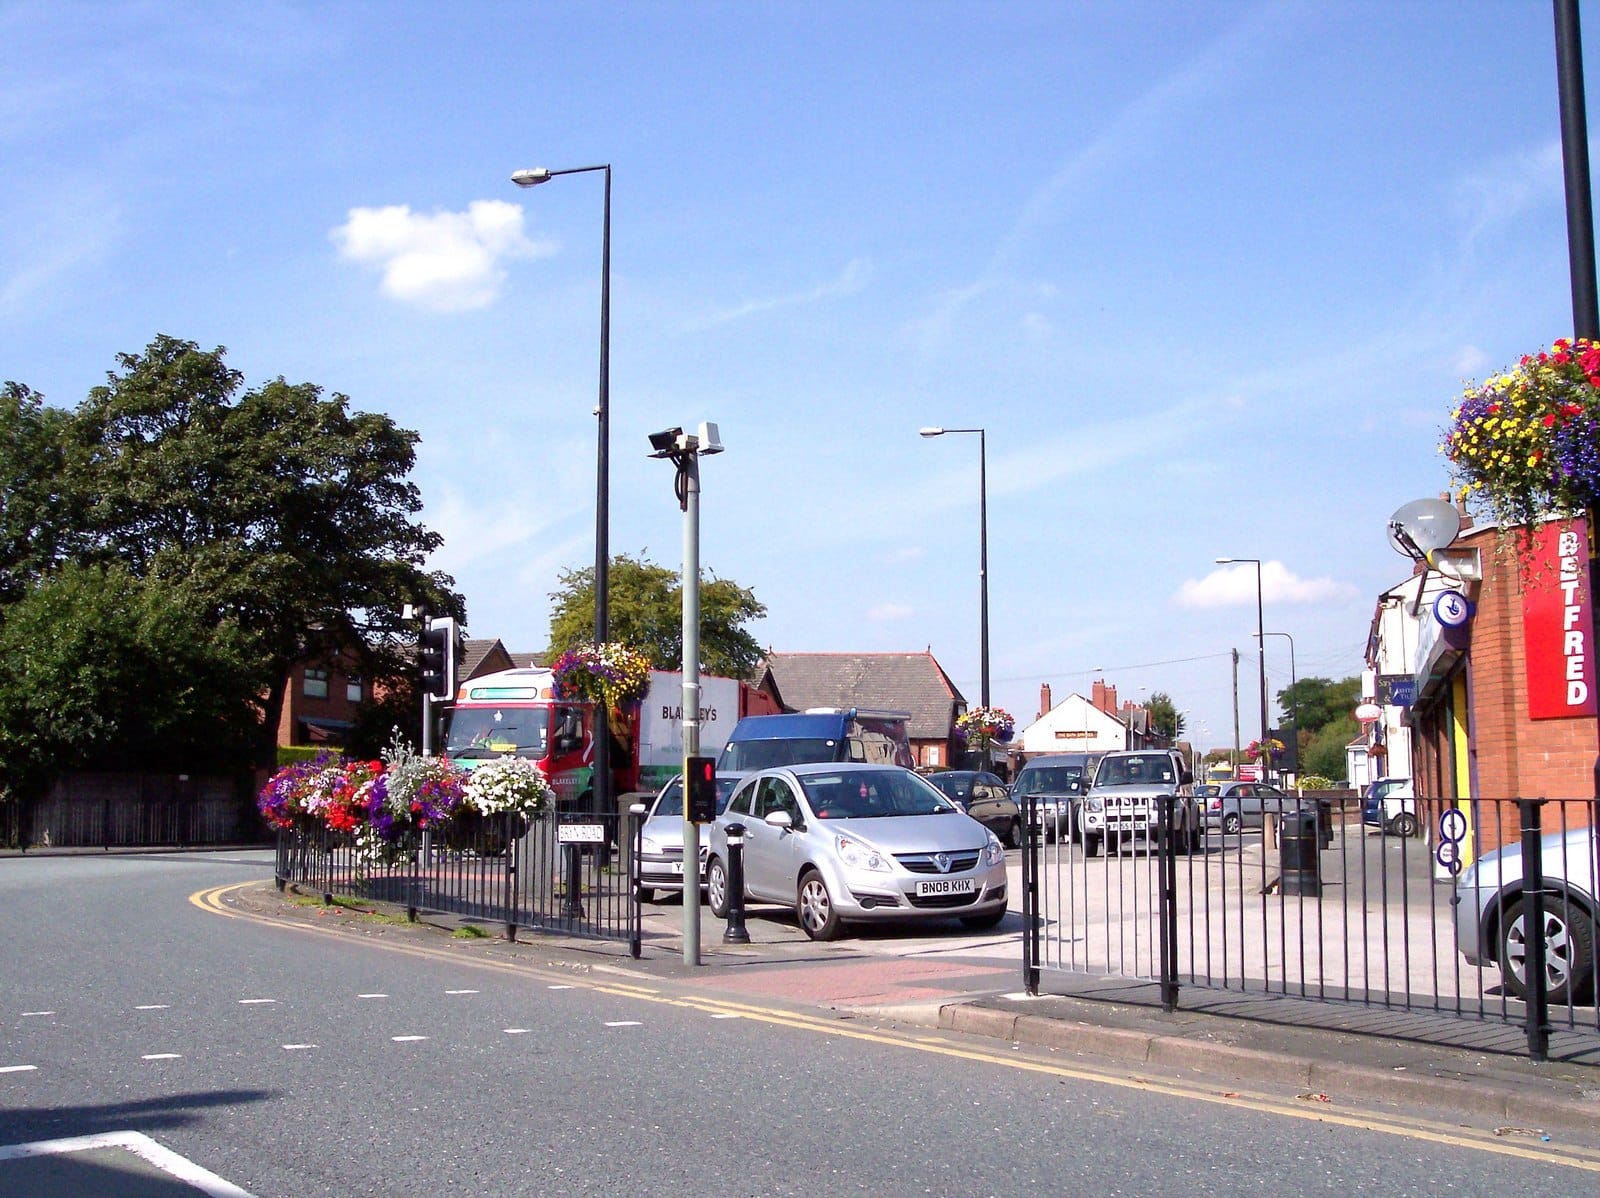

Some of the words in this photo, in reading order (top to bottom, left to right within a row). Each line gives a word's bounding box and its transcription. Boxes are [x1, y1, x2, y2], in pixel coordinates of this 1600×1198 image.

[1558, 532, 1588, 706] BETFRED
[662, 704, 717, 721] BLAEY'S
[921, 881, 949, 893] BN08
